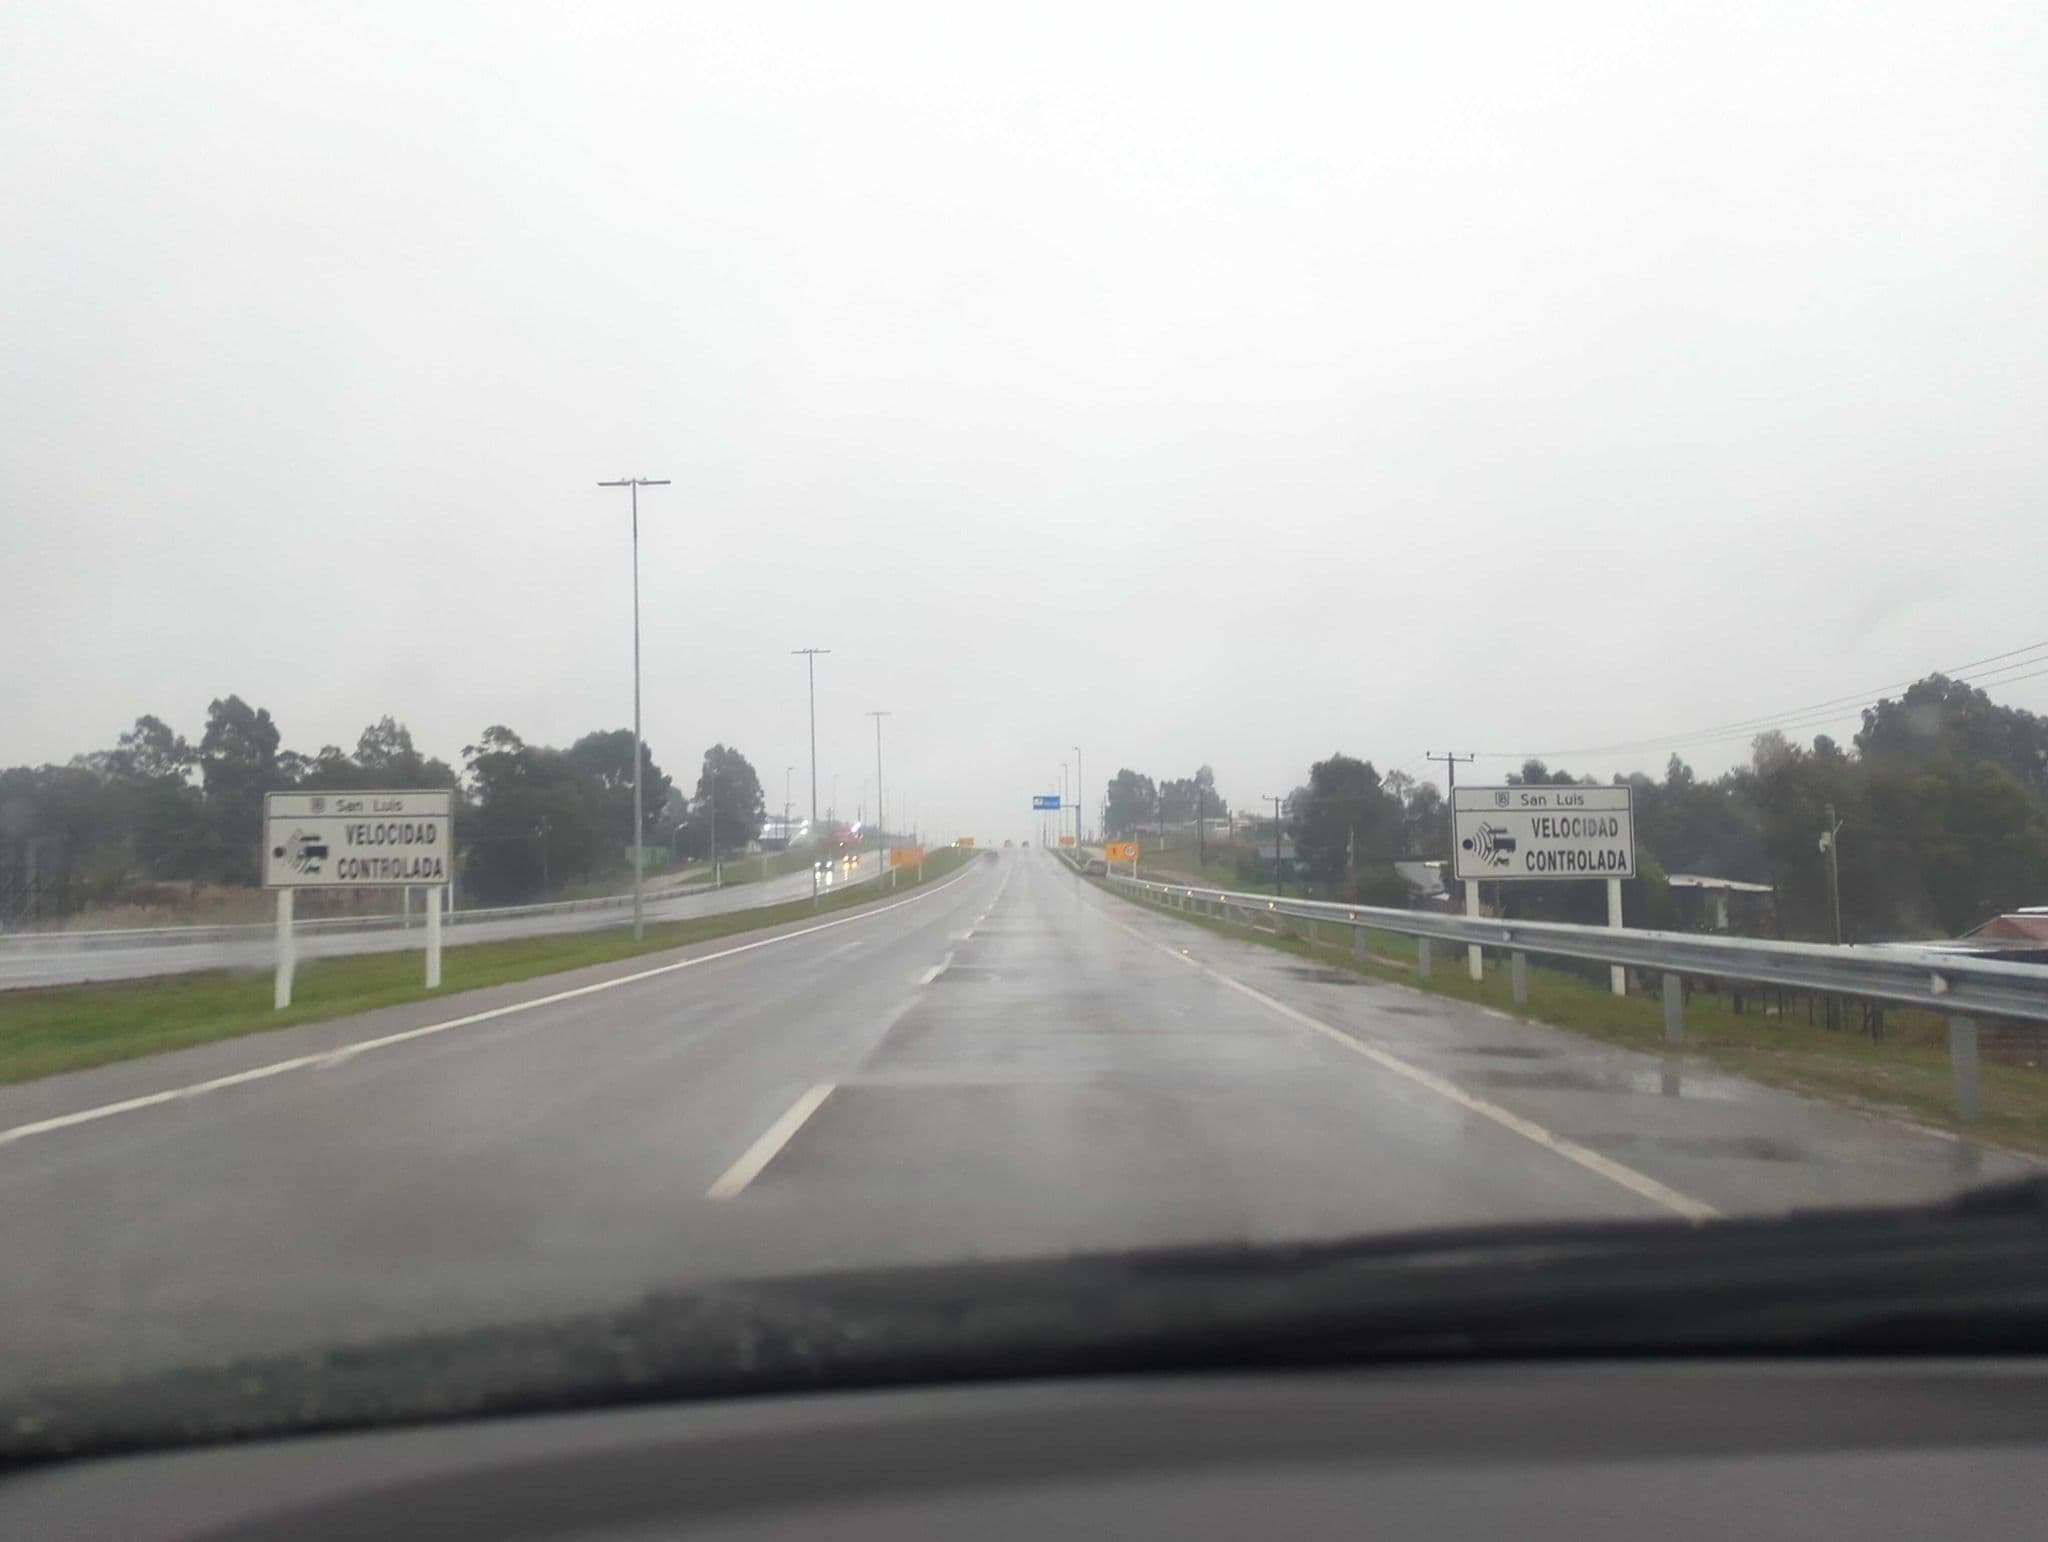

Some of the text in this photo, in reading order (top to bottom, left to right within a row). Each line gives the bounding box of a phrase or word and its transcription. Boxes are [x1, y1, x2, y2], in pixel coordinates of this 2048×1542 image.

[336, 799, 363, 812] San
[373, 799, 404, 812] Luis
[1521, 794, 1547, 806] San
[1557, 793, 1584, 806] Luis
[345, 823, 437, 845] VELOCIDAD
[1531, 817, 1619, 838] VELOCIDAD
[337, 856, 443, 880] CONTROLADA
[1525, 849, 1627, 871] CONTROLADA
